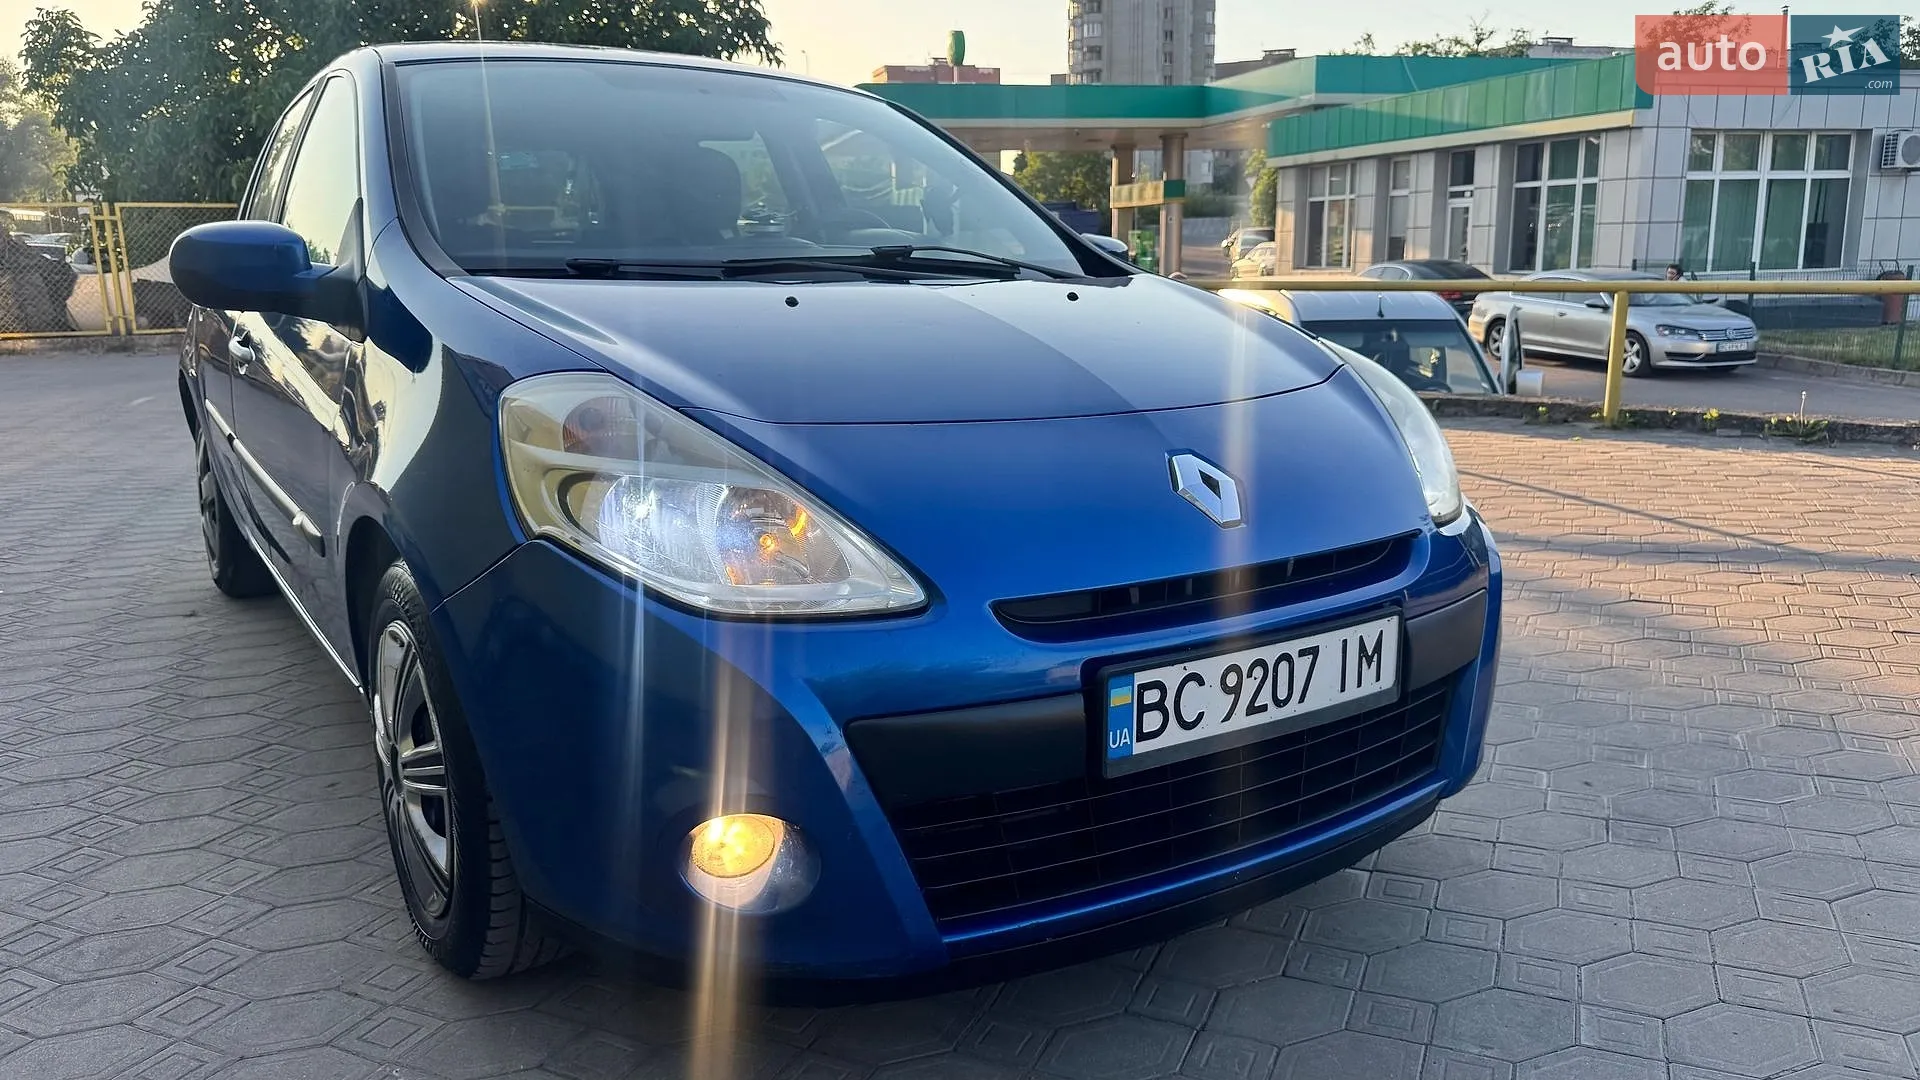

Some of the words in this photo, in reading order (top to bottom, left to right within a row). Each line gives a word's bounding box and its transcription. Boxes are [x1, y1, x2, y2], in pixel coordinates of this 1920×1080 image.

[1135, 671, 1206, 743] BC
[1219, 645, 1320, 723] 9207
[1338, 629, 1384, 693] IM
[1109, 727, 1131, 749] UA
